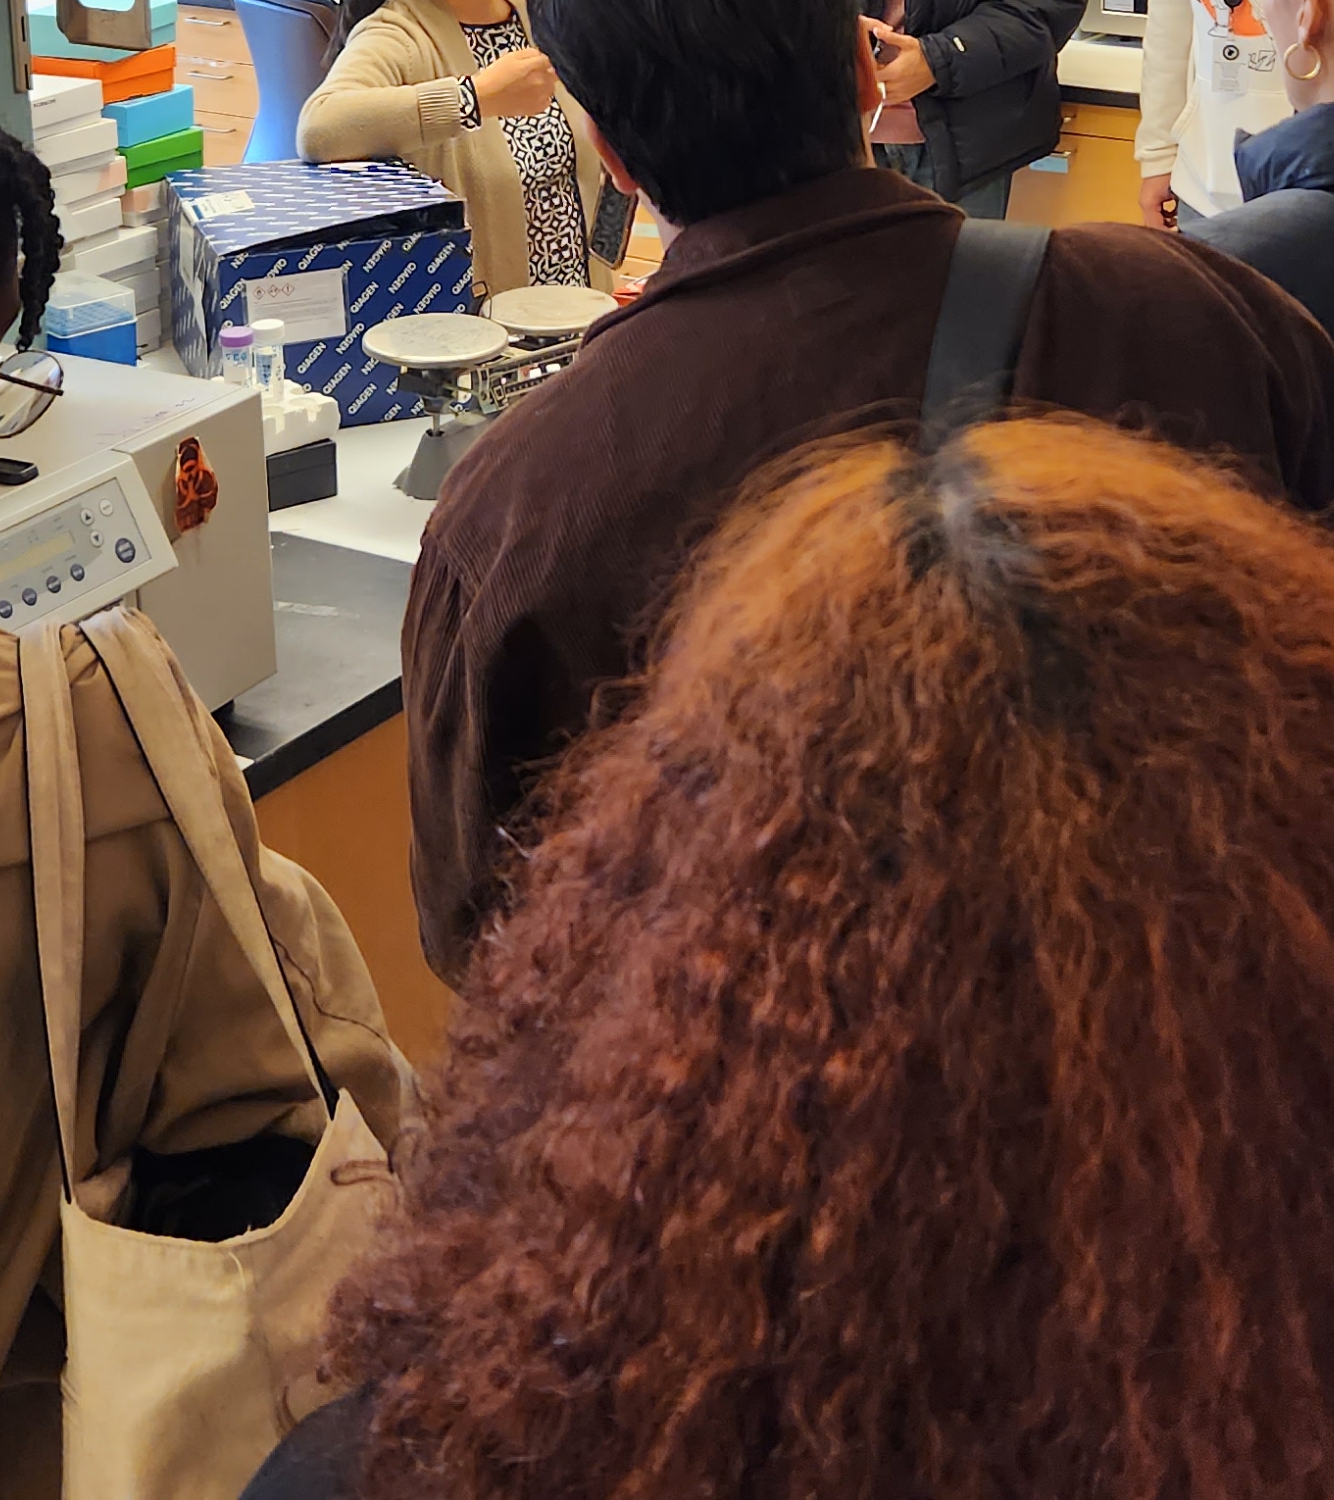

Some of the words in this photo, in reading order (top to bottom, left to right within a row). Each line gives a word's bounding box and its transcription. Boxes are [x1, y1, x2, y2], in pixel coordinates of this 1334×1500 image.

[363, 240, 392, 273] QIAGEN
[427, 241, 456, 274] QIAGEN
[388, 262, 417, 294] QIAGEN
[350, 281, 380, 313] QIAGEN
[335, 323, 365, 355] QIAGEN
[297, 341, 327, 374] QIAGEN
[322, 362, 352, 394] QIAGEN
[348, 382, 377, 415] QIAGEN
